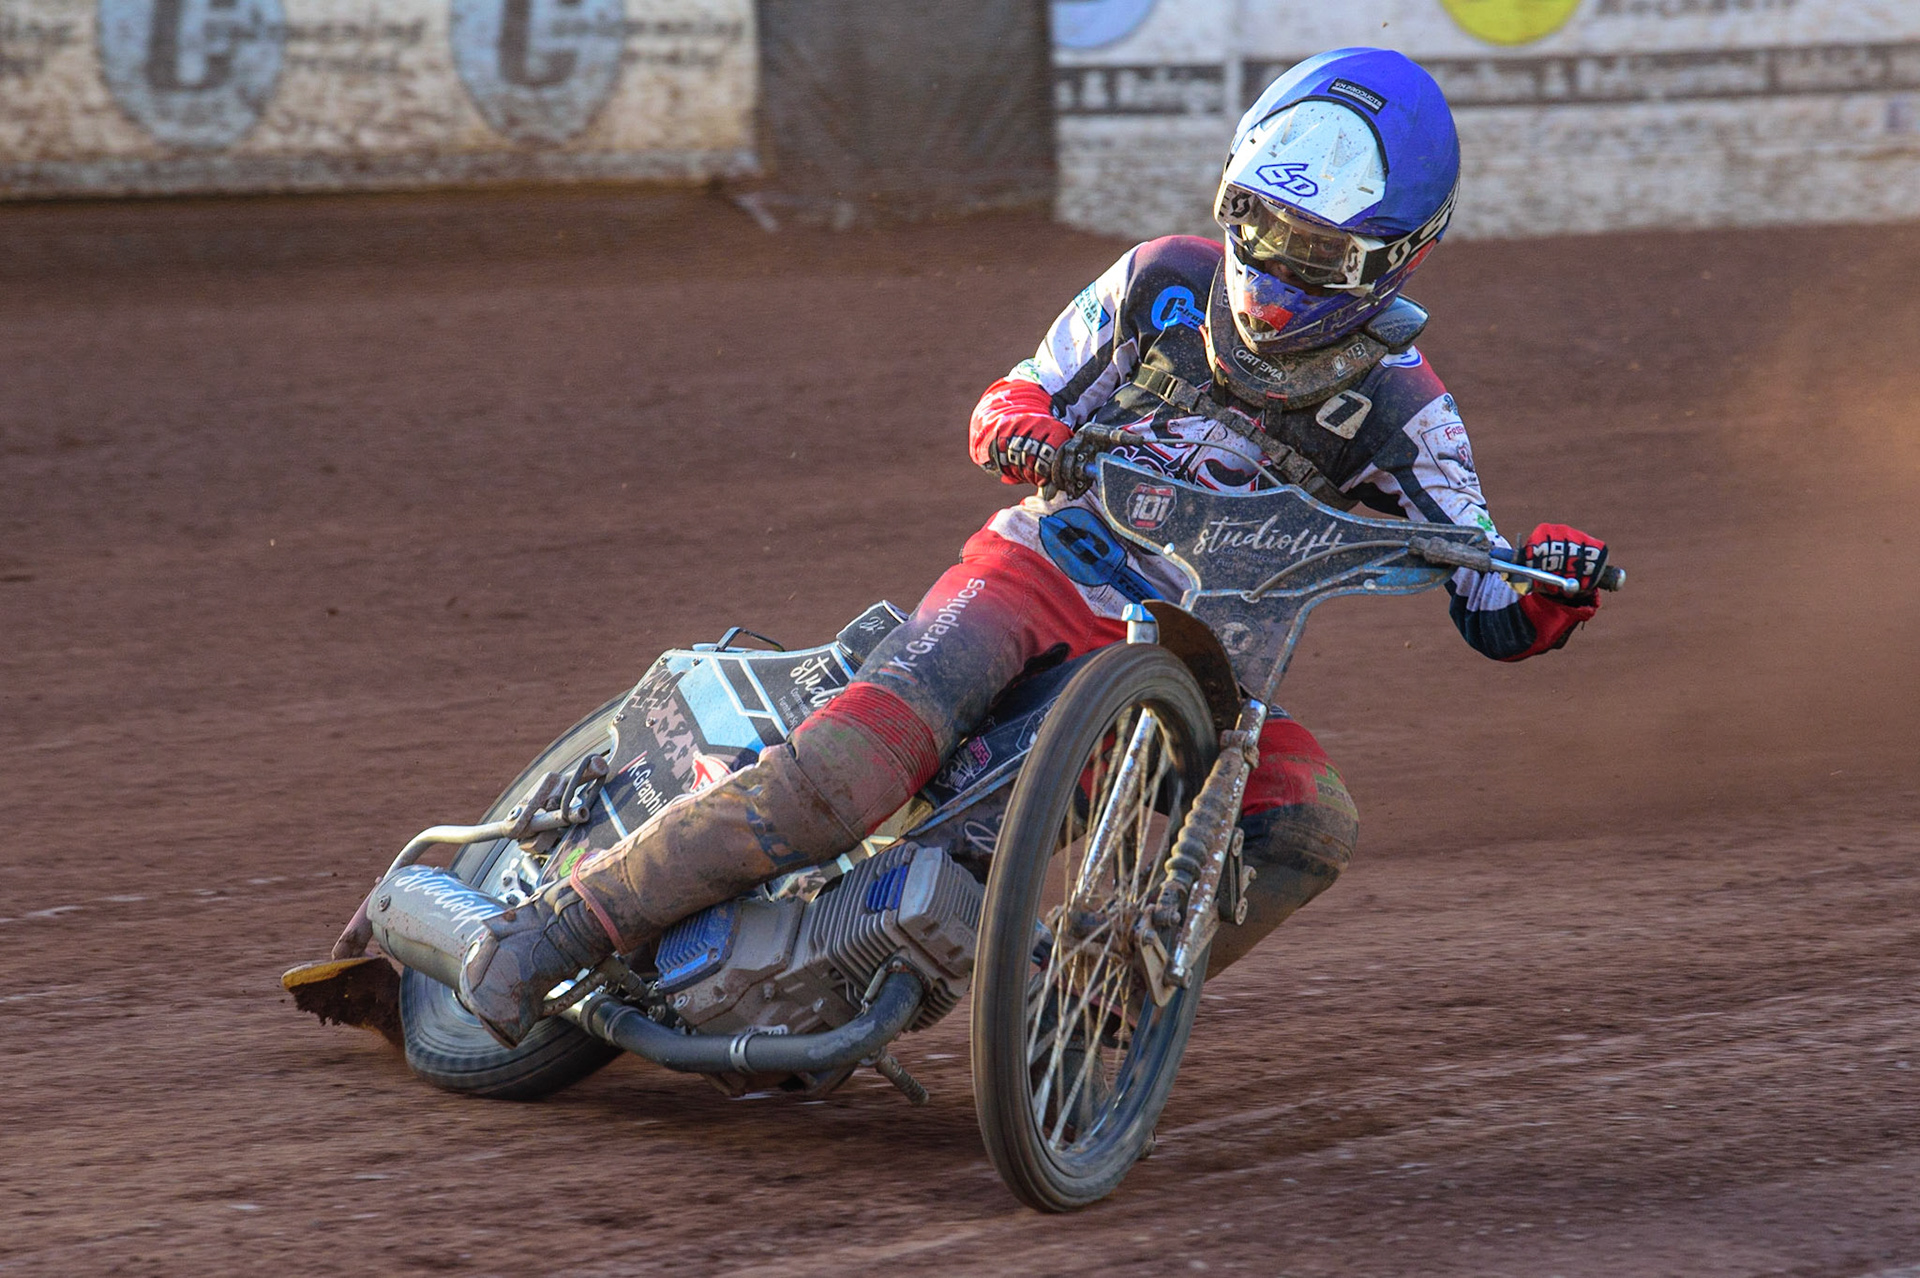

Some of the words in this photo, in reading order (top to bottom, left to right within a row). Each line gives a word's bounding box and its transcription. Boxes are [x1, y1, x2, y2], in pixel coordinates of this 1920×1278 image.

[1345, 84, 1383, 107] PRODUCTS
[1235, 348, 1284, 381] ORTEMA
[1131, 494, 1171, 522] 101
[888, 577, 986, 673] K-Graphics
[627, 757, 668, 816] K-Graphi
